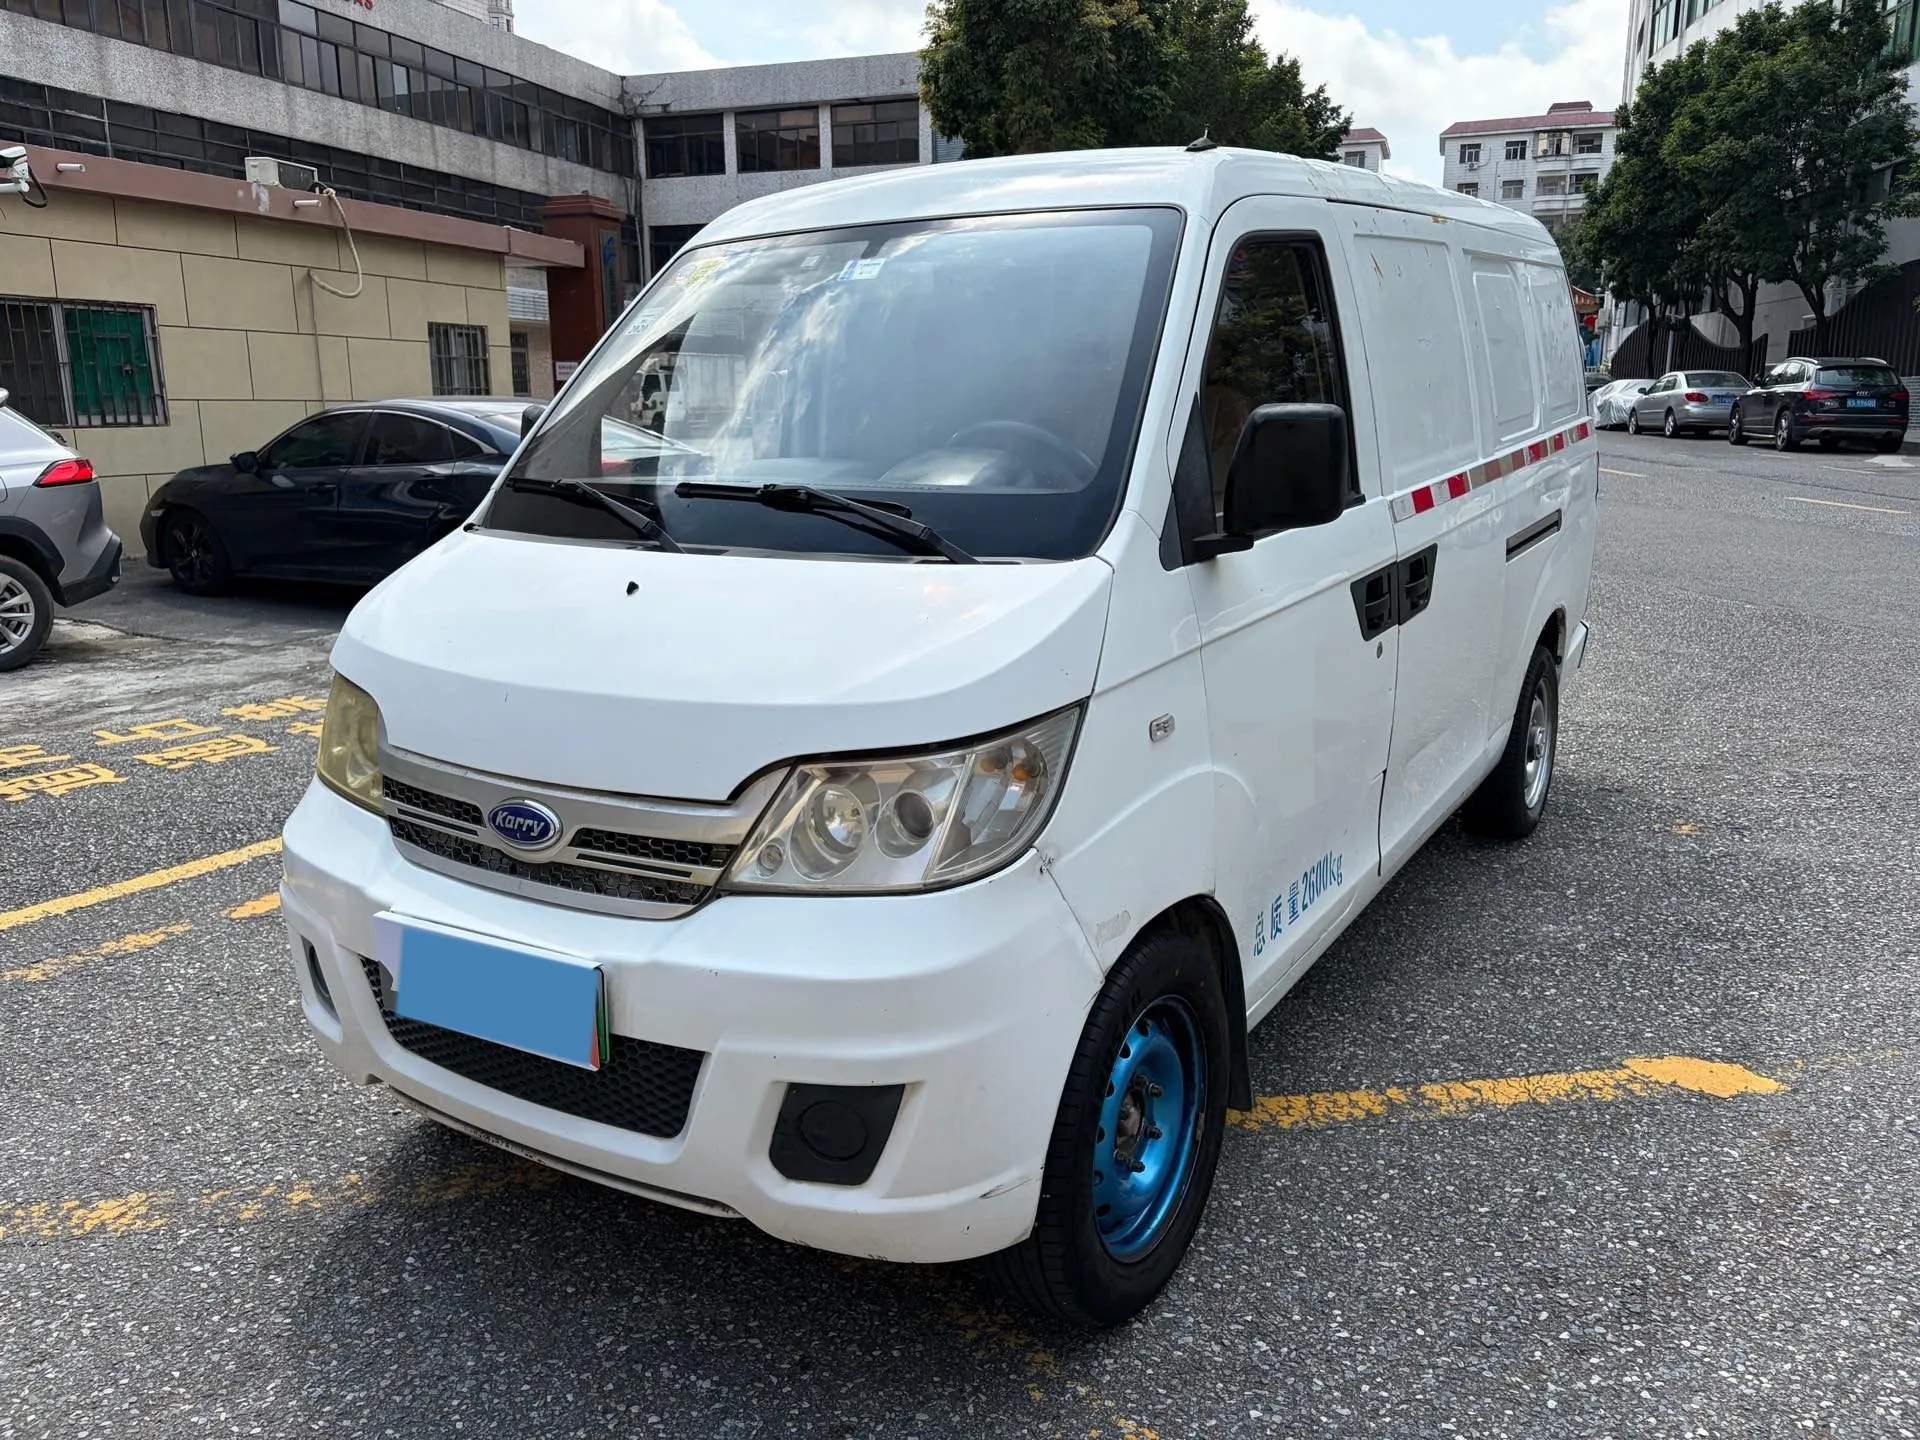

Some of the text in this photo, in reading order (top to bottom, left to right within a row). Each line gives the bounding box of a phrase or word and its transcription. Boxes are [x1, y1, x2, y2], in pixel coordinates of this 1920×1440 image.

[495, 810, 545, 837] Karry
[1253, 851, 1343, 957] 总质量2600kg
